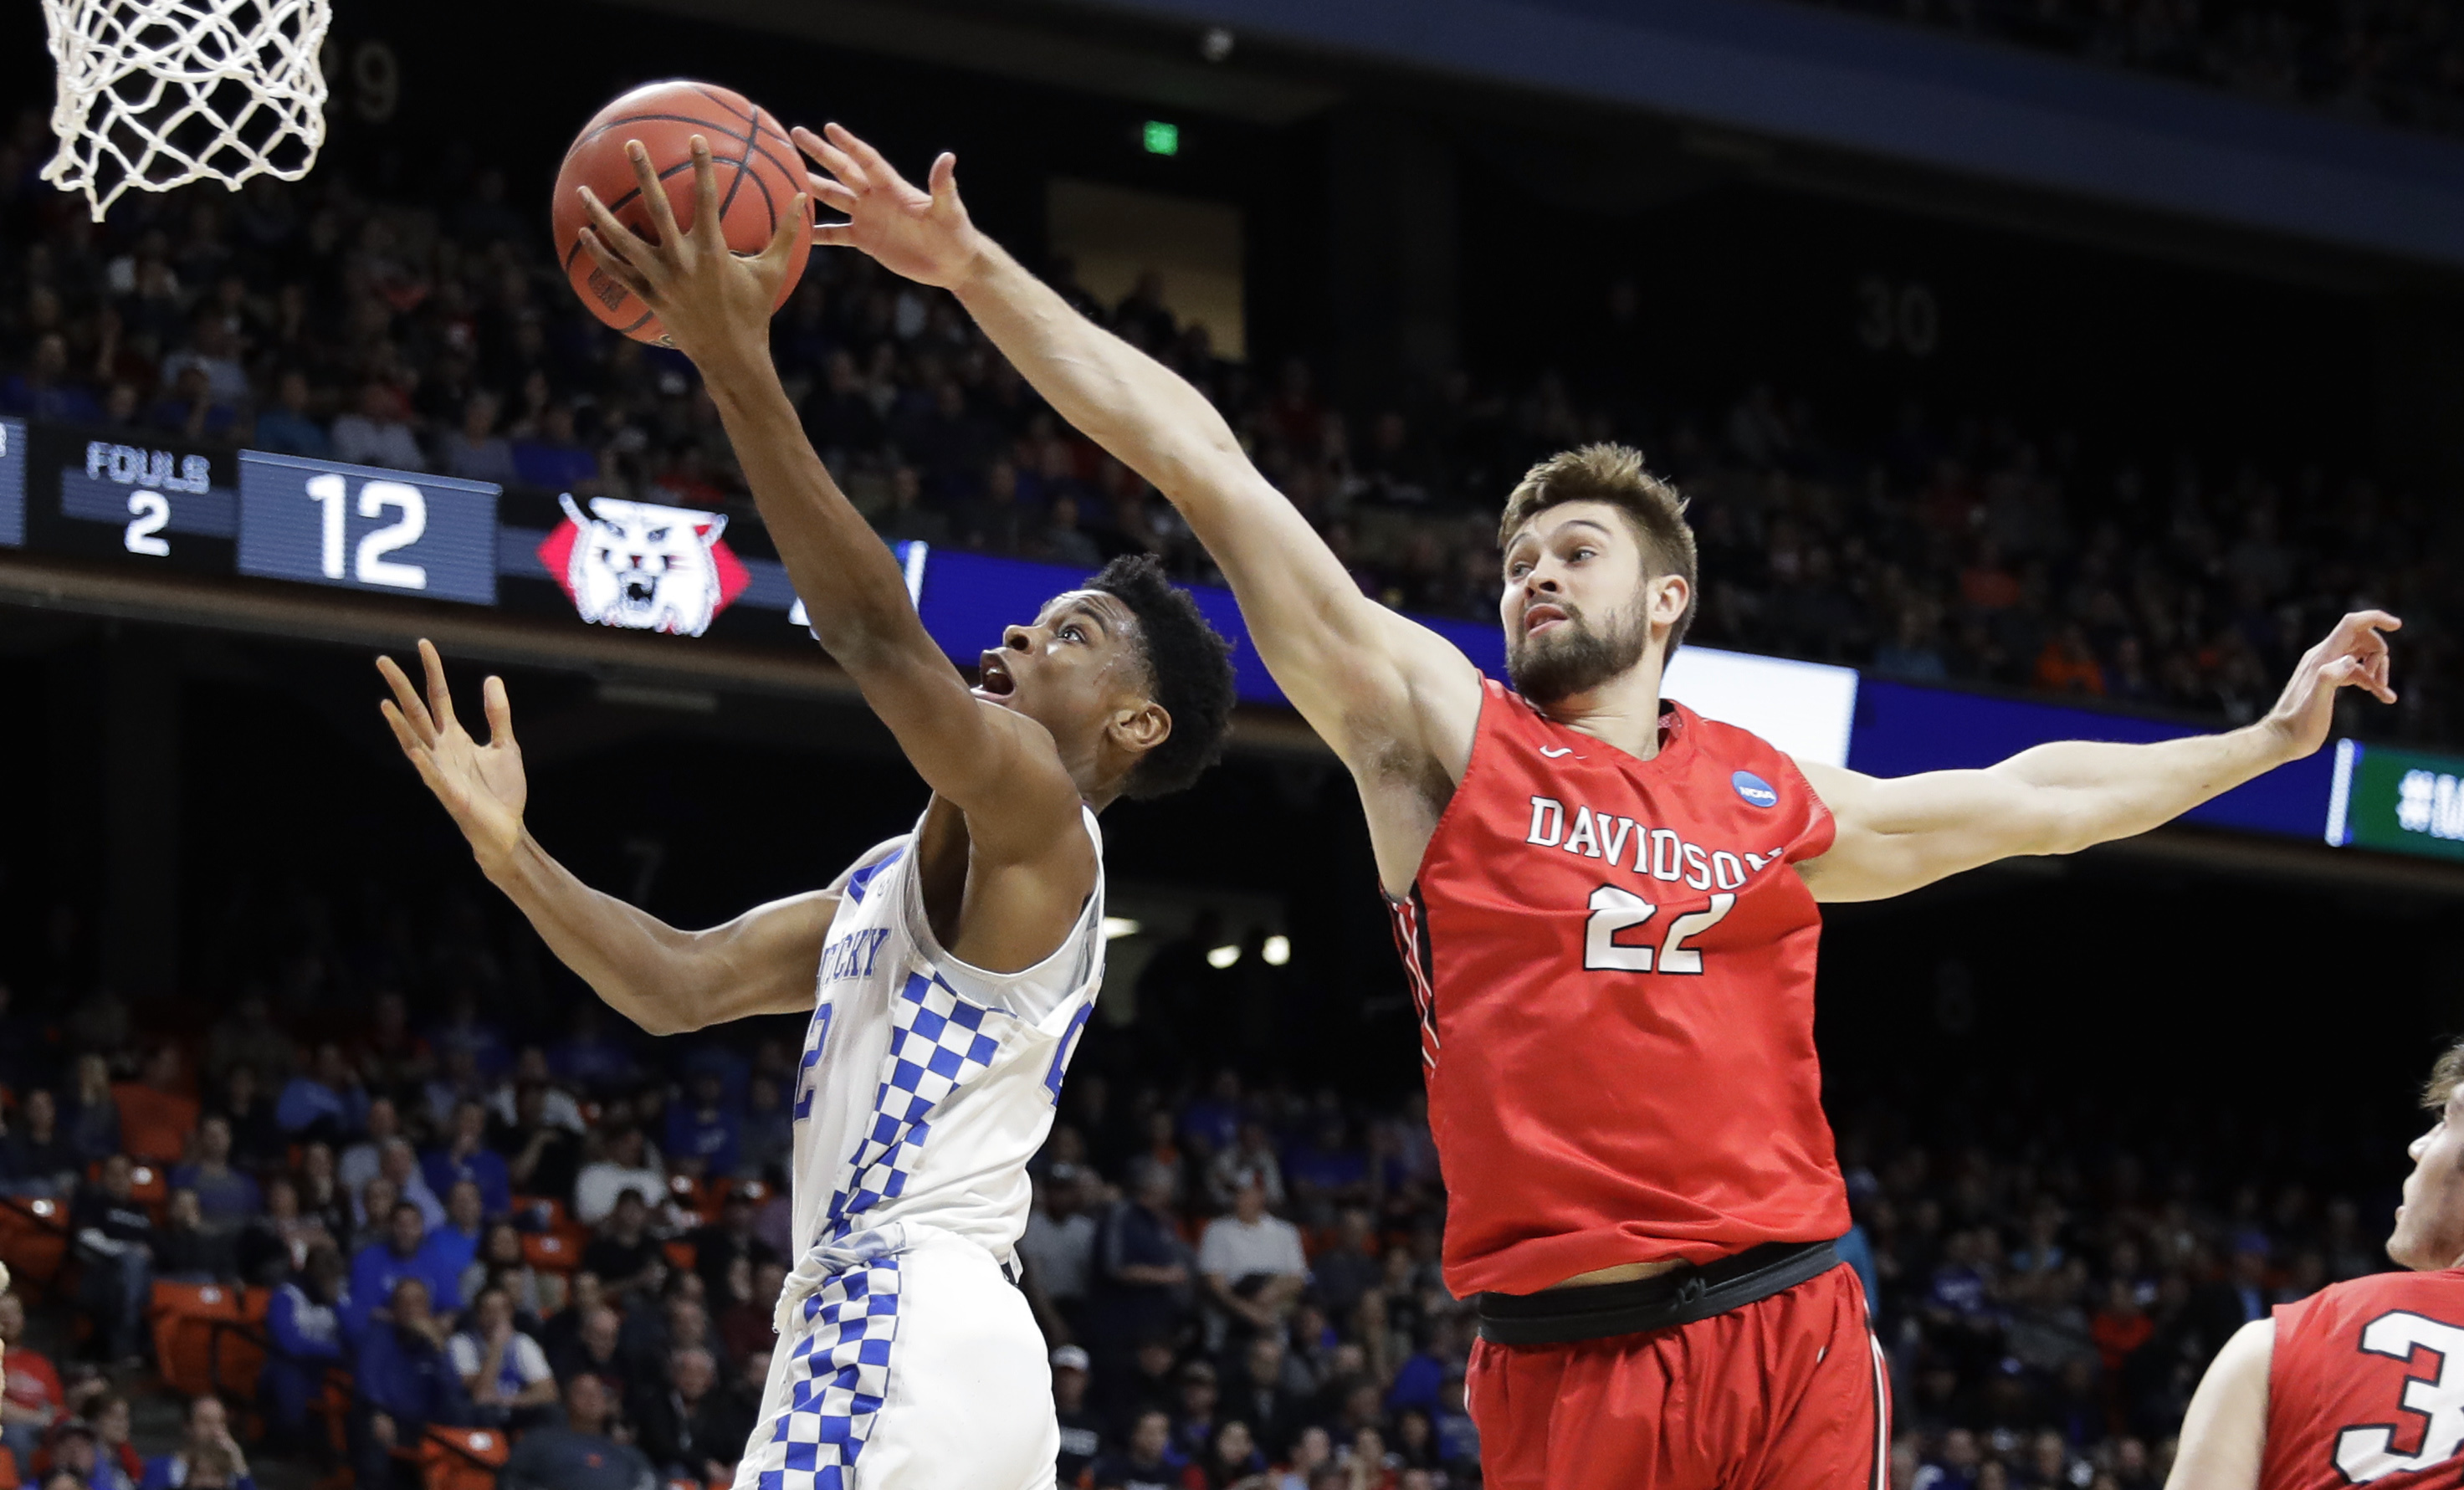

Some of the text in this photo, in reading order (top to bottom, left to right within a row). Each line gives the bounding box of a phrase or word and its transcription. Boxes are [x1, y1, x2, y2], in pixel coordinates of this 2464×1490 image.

[1855, 276, 1937, 356] 30
[86, 441, 210, 494] FOULS
[125, 489, 171, 557] 2
[305, 474, 428, 590] 12
[1739, 786, 1777, 801] NCAA
[622, 837, 665, 906] 7
[1583, 884, 1737, 975] 22
[2331, 1309, 2464, 1484] 3
